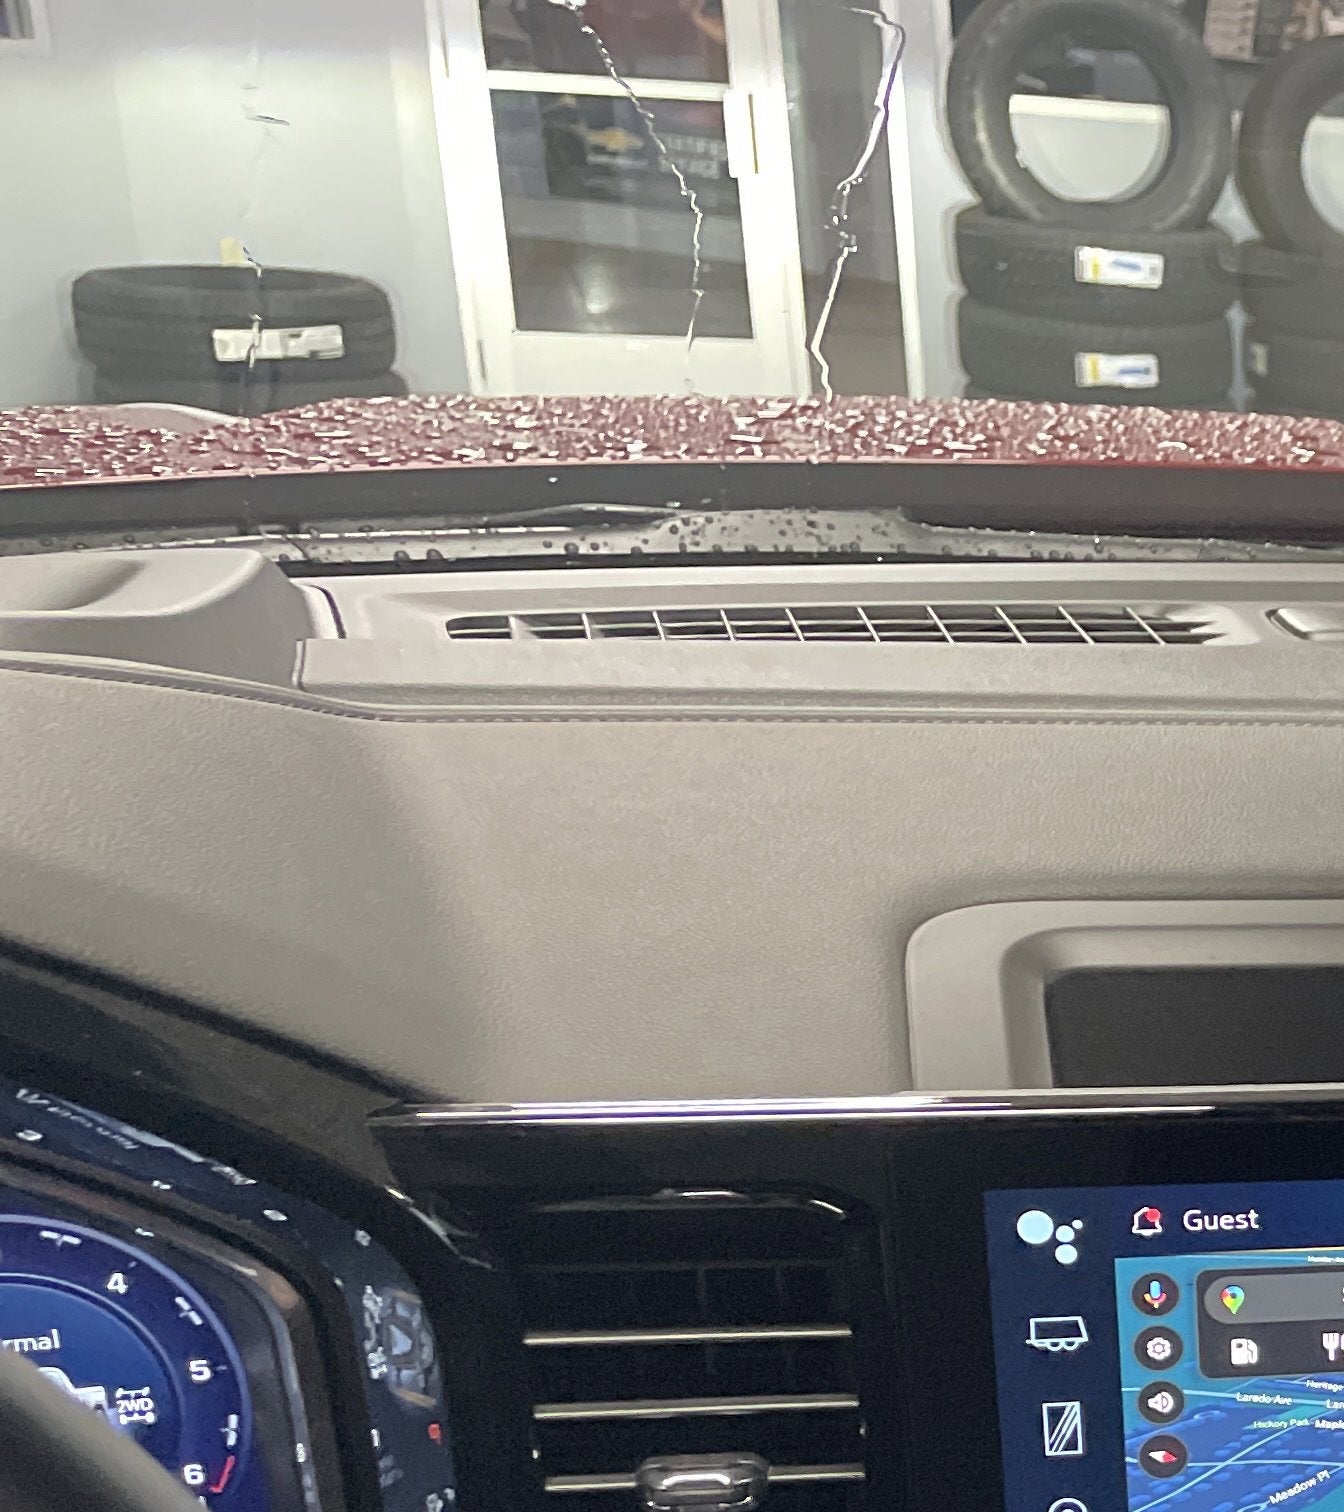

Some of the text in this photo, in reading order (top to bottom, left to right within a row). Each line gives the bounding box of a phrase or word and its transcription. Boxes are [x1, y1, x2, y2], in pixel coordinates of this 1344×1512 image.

[1183, 1209, 1259, 1230] Guest
[107, 1272, 128, 1294] 4
[189, 1359, 211, 1381] 5
[116, 1397, 155, 1414] 2WD
[1236, 1392, 1292, 1406] Laredo Ave
[1289, 1418, 1310, 1427] Park
[184, 1464, 205, 1486] 6
[1269, 1479, 1317, 1504] Meadow
